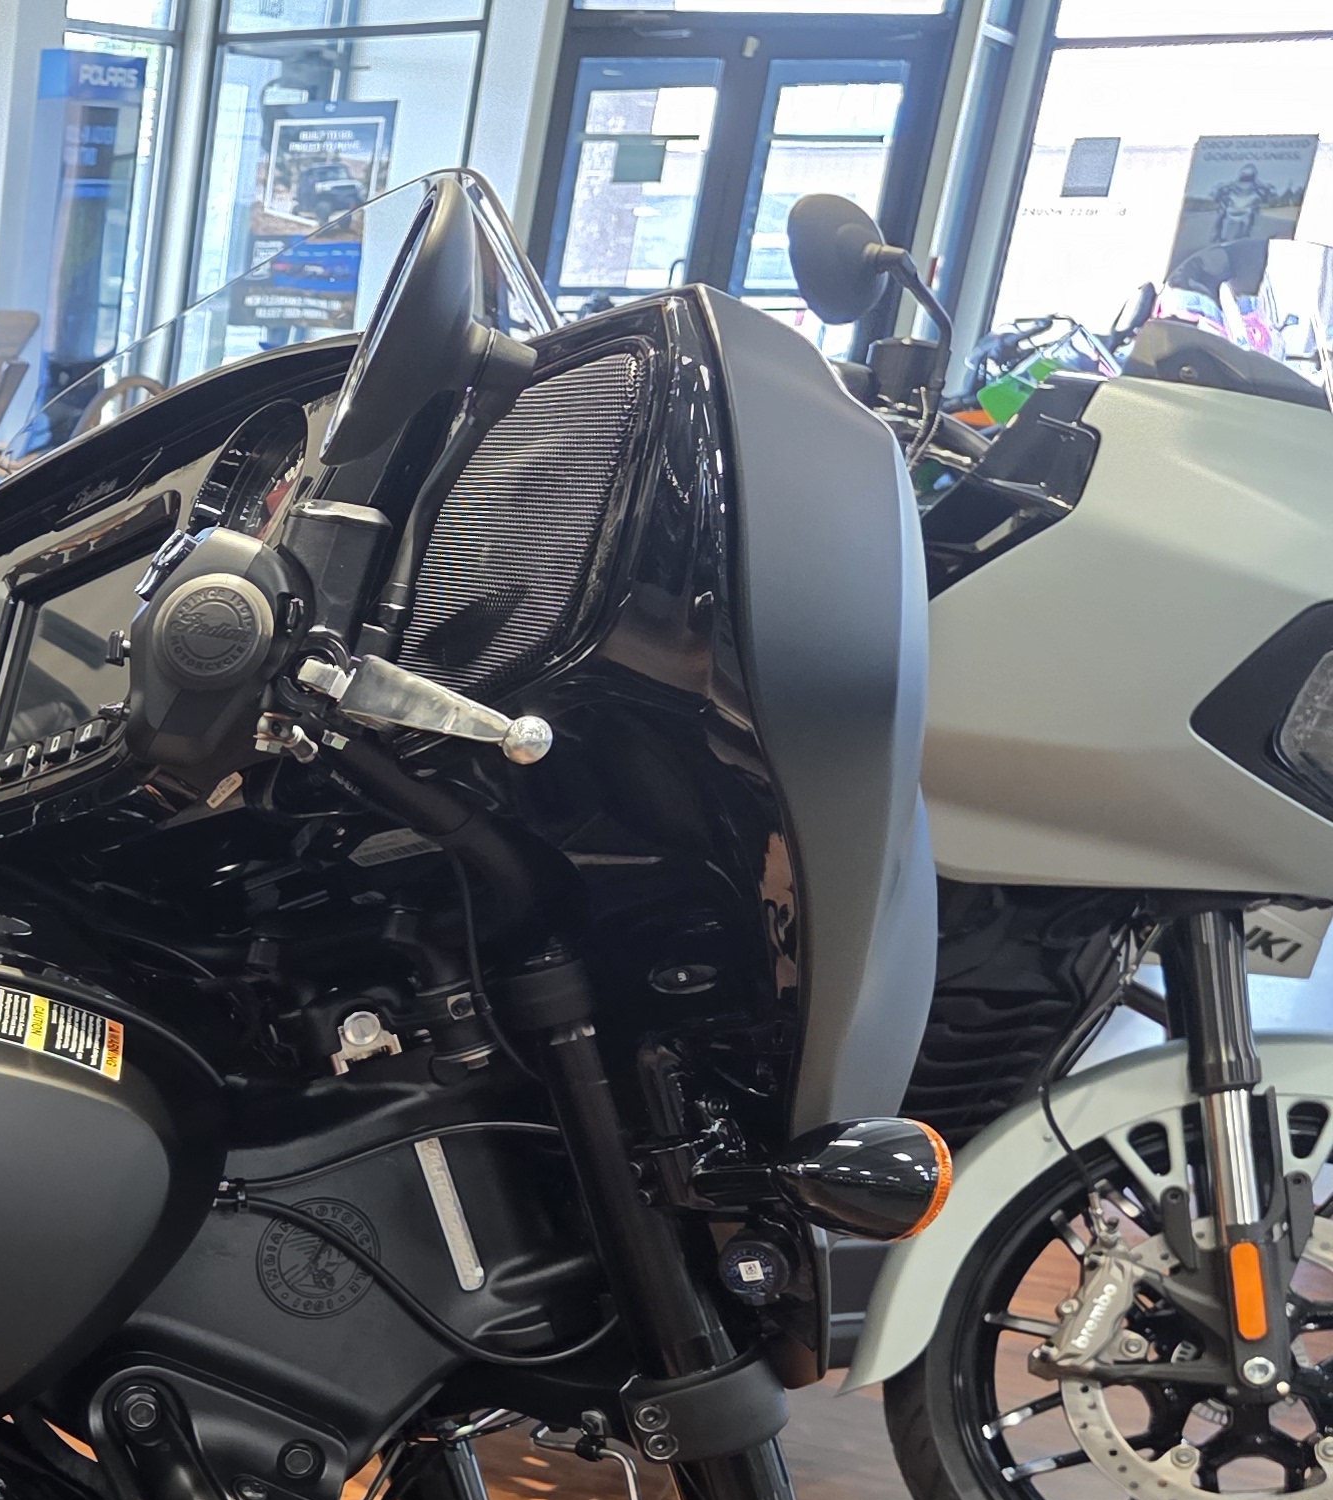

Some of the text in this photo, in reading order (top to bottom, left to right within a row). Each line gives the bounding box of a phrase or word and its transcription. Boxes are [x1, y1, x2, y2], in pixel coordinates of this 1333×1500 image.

[78, 63, 139, 89] POLARIS
[170, 611, 254, 643] Indian
[31, 1005, 45, 1037] CAUTION
[106, 1033, 120, 1068] WARNING
[1070, 1283, 1118, 1350] brembo
